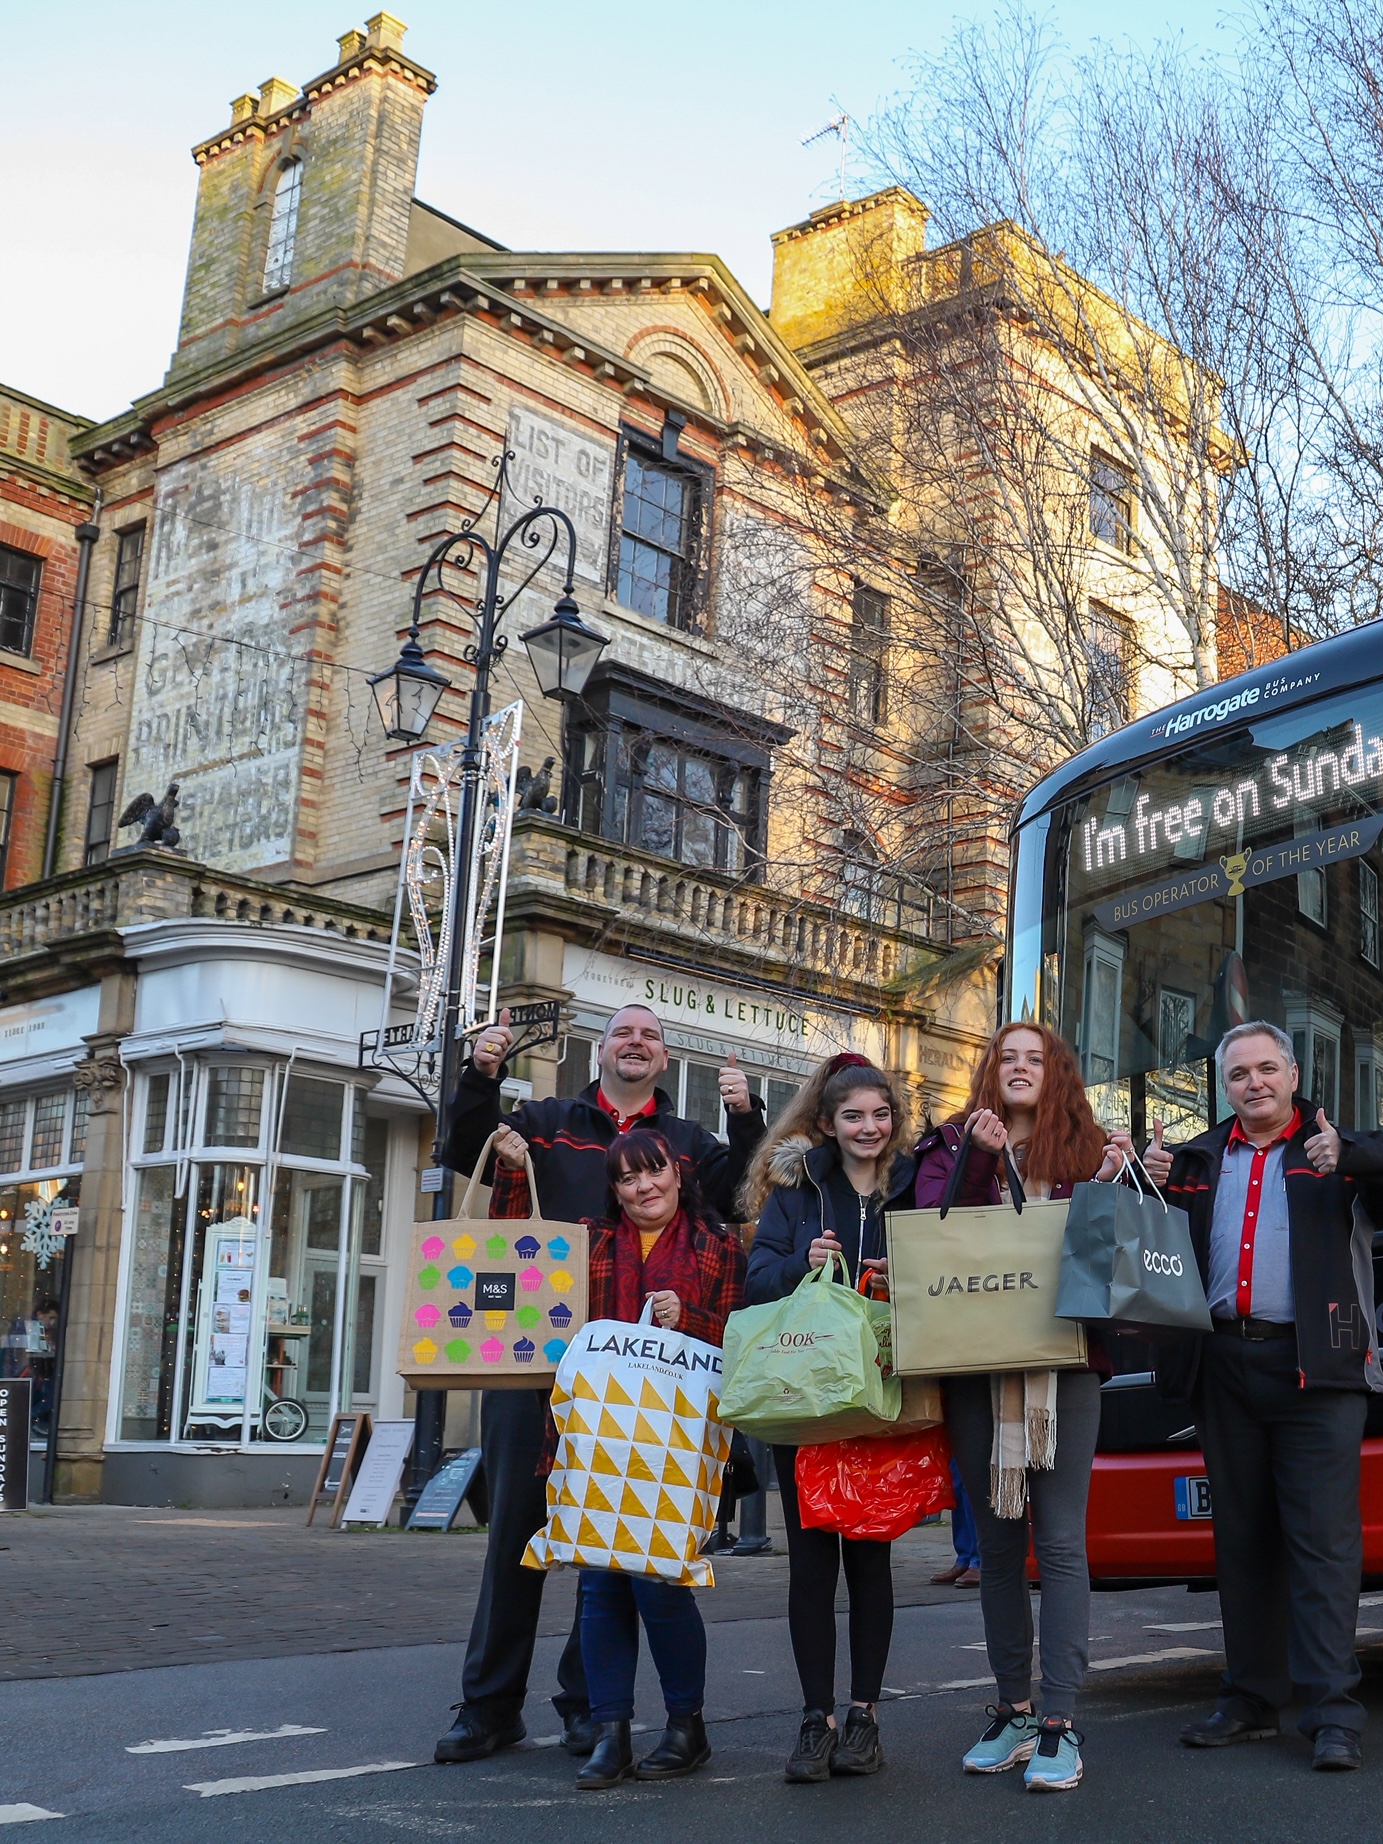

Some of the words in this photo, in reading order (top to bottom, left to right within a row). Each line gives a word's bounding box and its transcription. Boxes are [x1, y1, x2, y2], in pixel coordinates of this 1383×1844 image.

[510, 412, 566, 464] LIST
[576, 449, 608, 485] OF
[1264, 673, 1321, 699] COMPANY
[1266, 677, 1286, 690] BUS
[1152, 725, 1166, 735] THE
[1165, 687, 1260, 738] Harrogate
[1083, 816, 1127, 871] I'm
[1135, 793, 1202, 853] free
[1213, 779, 1260, 827] on
[1252, 858, 1274, 877] OF
[1279, 846, 1311, 868] THE
[1315, 830, 1360, 857] YEAR
[1114, 900, 1138, 922] BUS
[1142, 874, 1219, 911] OPERATOR
[645, 979, 697, 1010] SLUG
[706, 994, 716, 1014] &
[725, 999, 811, 1036] LETTUCE
[677, 1033, 709, 1051] SLUG
[919, 1045, 963, 1071] HERALD
[1144, 1249, 1183, 1277] ecco
[482, 1284, 508, 1294] M&S
[927, 1272, 1038, 1297] JAEGER
[628, 1362, 684, 1381] LAKELAND.CO.UK
[0, 1389, 9, 1427] OPEN
[1177, 1503, 1186, 1512] GB
